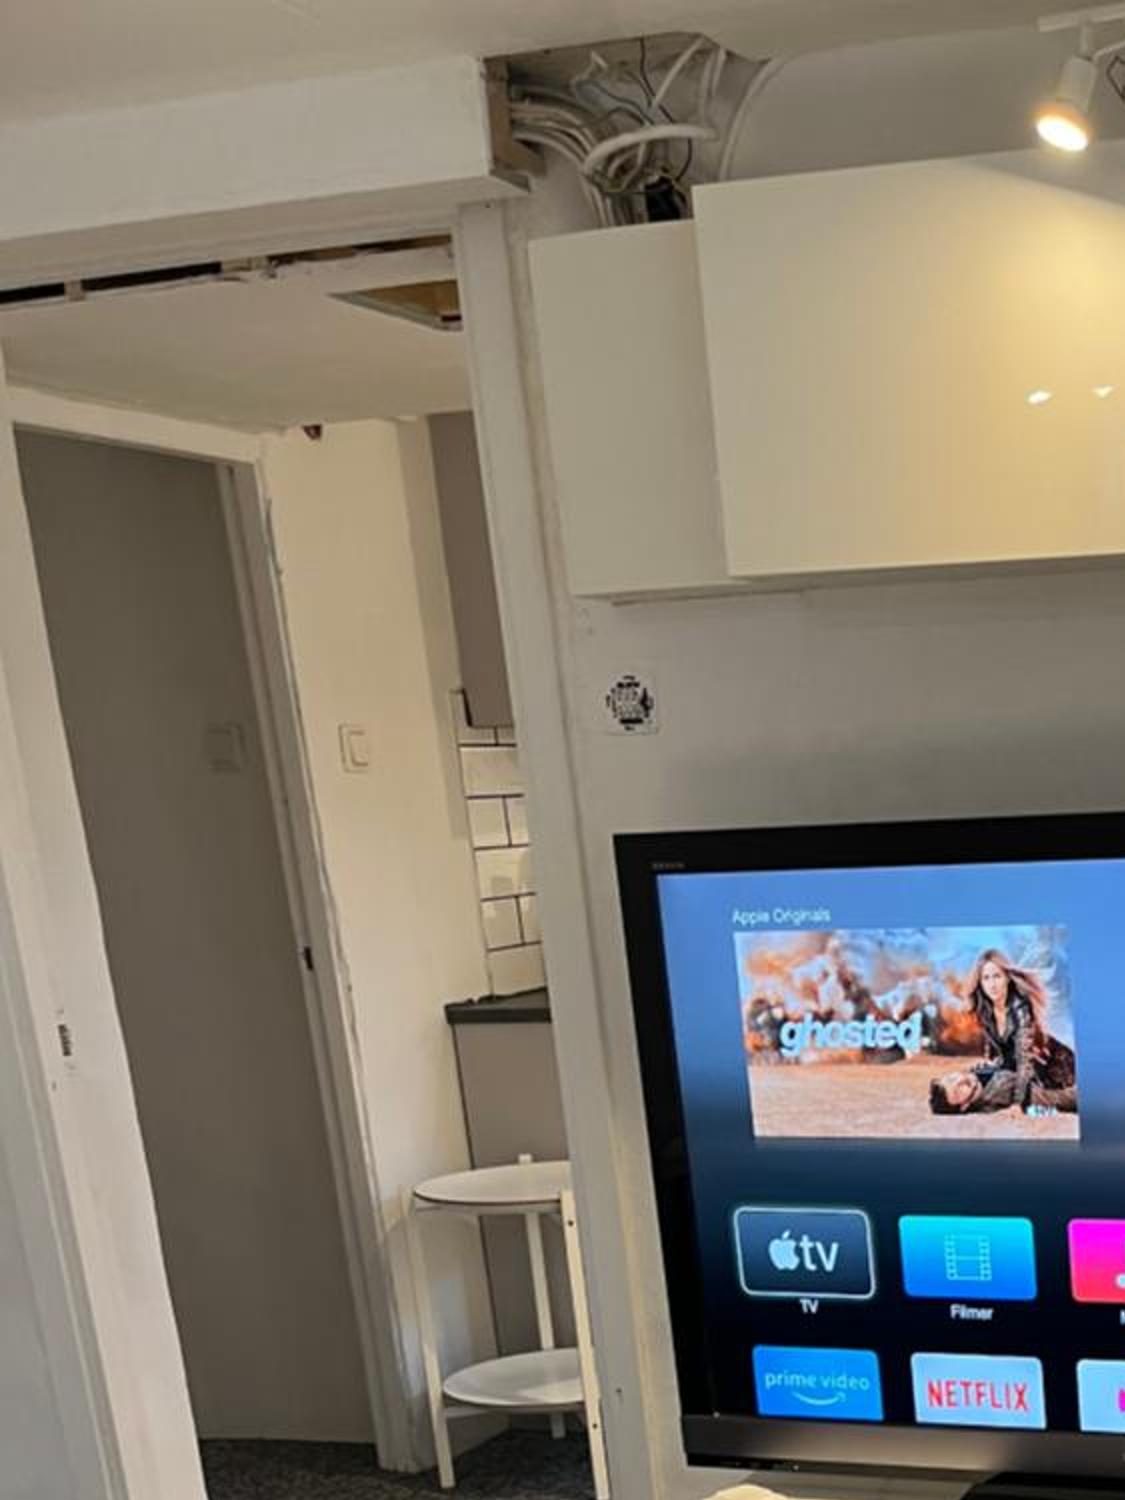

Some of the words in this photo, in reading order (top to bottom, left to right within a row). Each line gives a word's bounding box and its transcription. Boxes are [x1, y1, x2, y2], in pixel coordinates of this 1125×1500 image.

[780, 1012, 923, 1057] ghosted
[800, 1234, 838, 1273] tv
[950, 1304, 994, 1322] Filmer
[765, 1369, 817, 1390] prime
[820, 1371, 871, 1391] video
[928, 1380, 1029, 1412] NETFLIX
